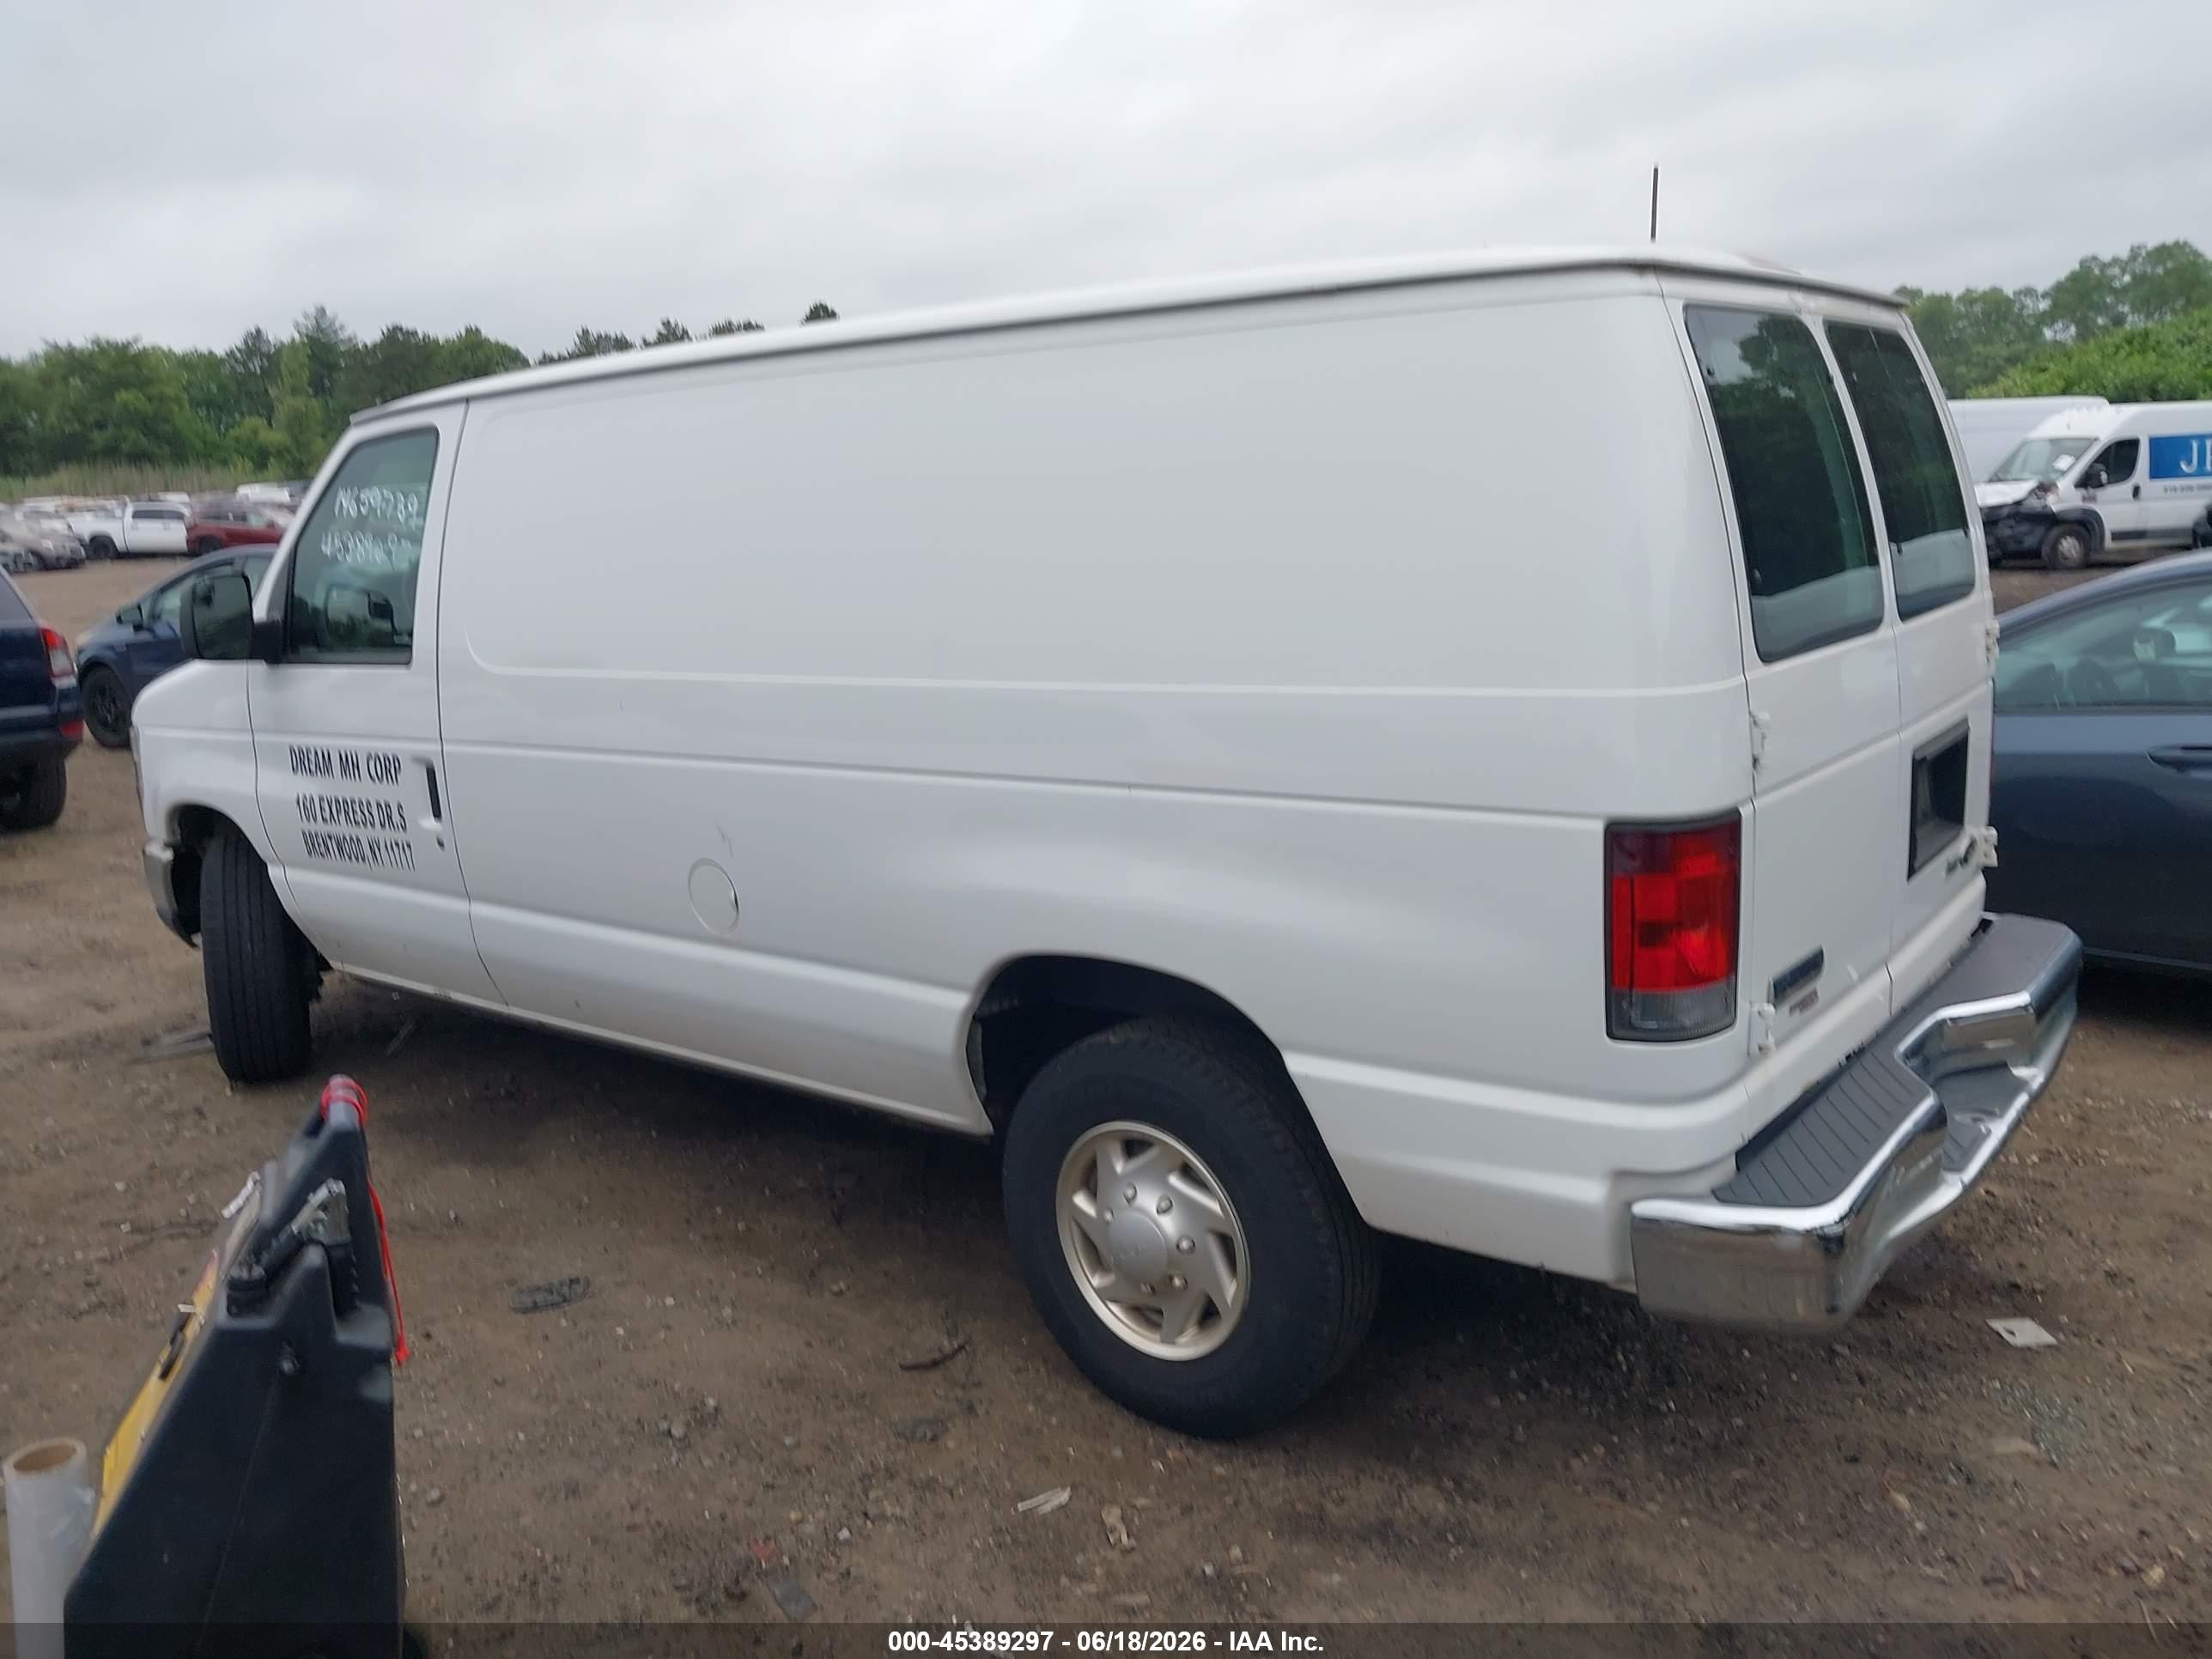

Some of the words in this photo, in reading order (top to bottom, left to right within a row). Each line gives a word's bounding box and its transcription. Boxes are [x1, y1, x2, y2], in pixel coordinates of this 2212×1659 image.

[289, 744, 335, 779] DREAM
[338, 749, 362, 782] MH
[367, 750, 402, 785] CORP
[296, 792, 317, 823] 160
[319, 794, 375, 829] EXPRESS
[385, 838, 416, 872] 11717
